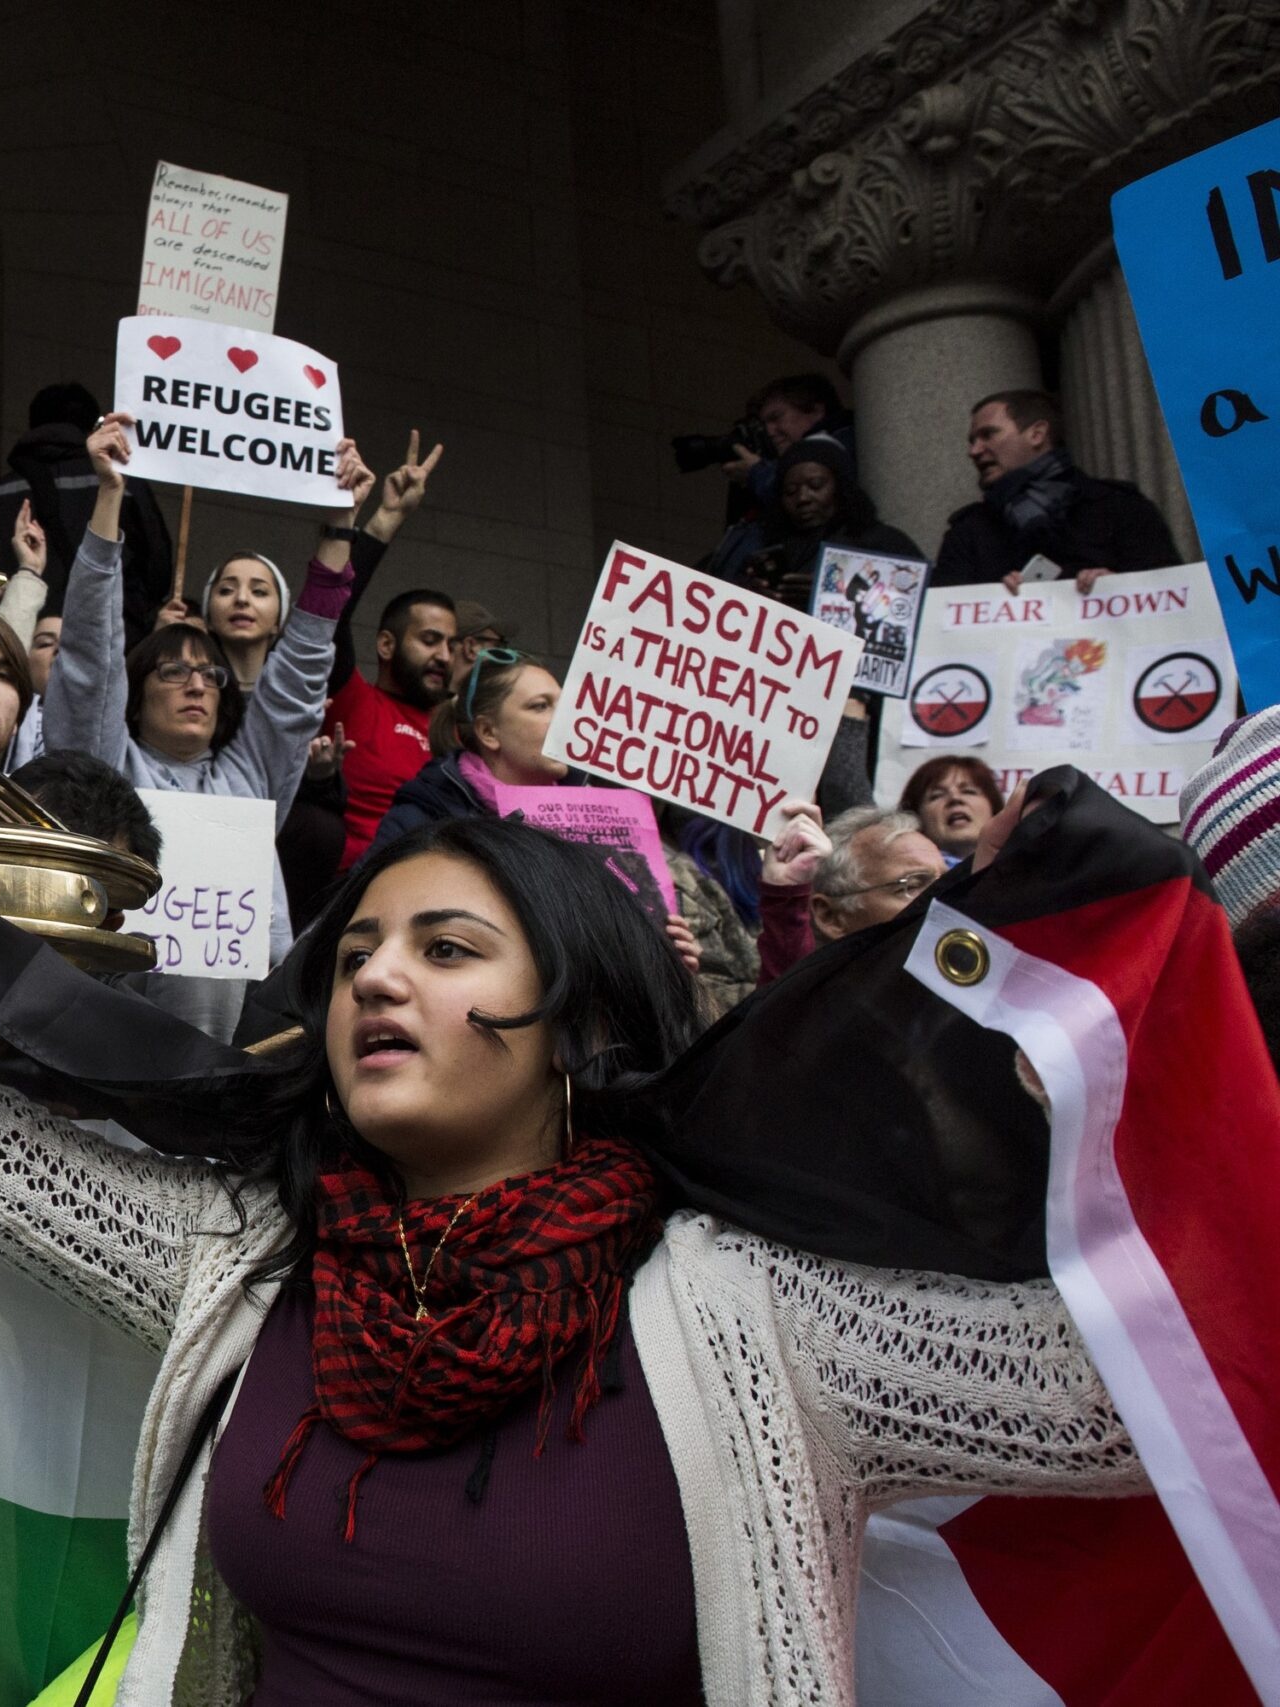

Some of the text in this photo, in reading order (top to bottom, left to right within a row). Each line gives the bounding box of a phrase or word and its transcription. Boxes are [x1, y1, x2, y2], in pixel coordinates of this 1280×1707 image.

[152, 208, 276, 255] ALL OF US
[153, 237, 270, 271] are descended
[194, 258, 223, 271] from
[143, 261, 275, 318] IMMIGRANTS
[143, 375, 332, 432] REFUGEES
[135, 419, 335, 477] WELCOME
[602, 549, 843, 700] FASCISM
[947, 587, 1189, 625] TEAR DOWN
[583, 622, 818, 740] IS A THREAT TO
[575, 672, 779, 785] NATIONAL
[566, 717, 788, 834] SECURITY
[1086, 771, 1178, 797] ALL
[537, 802, 620, 816] OUR DIVERSITY
[565, 814, 580, 823] US
[204, 936, 250, 969] U.S.
